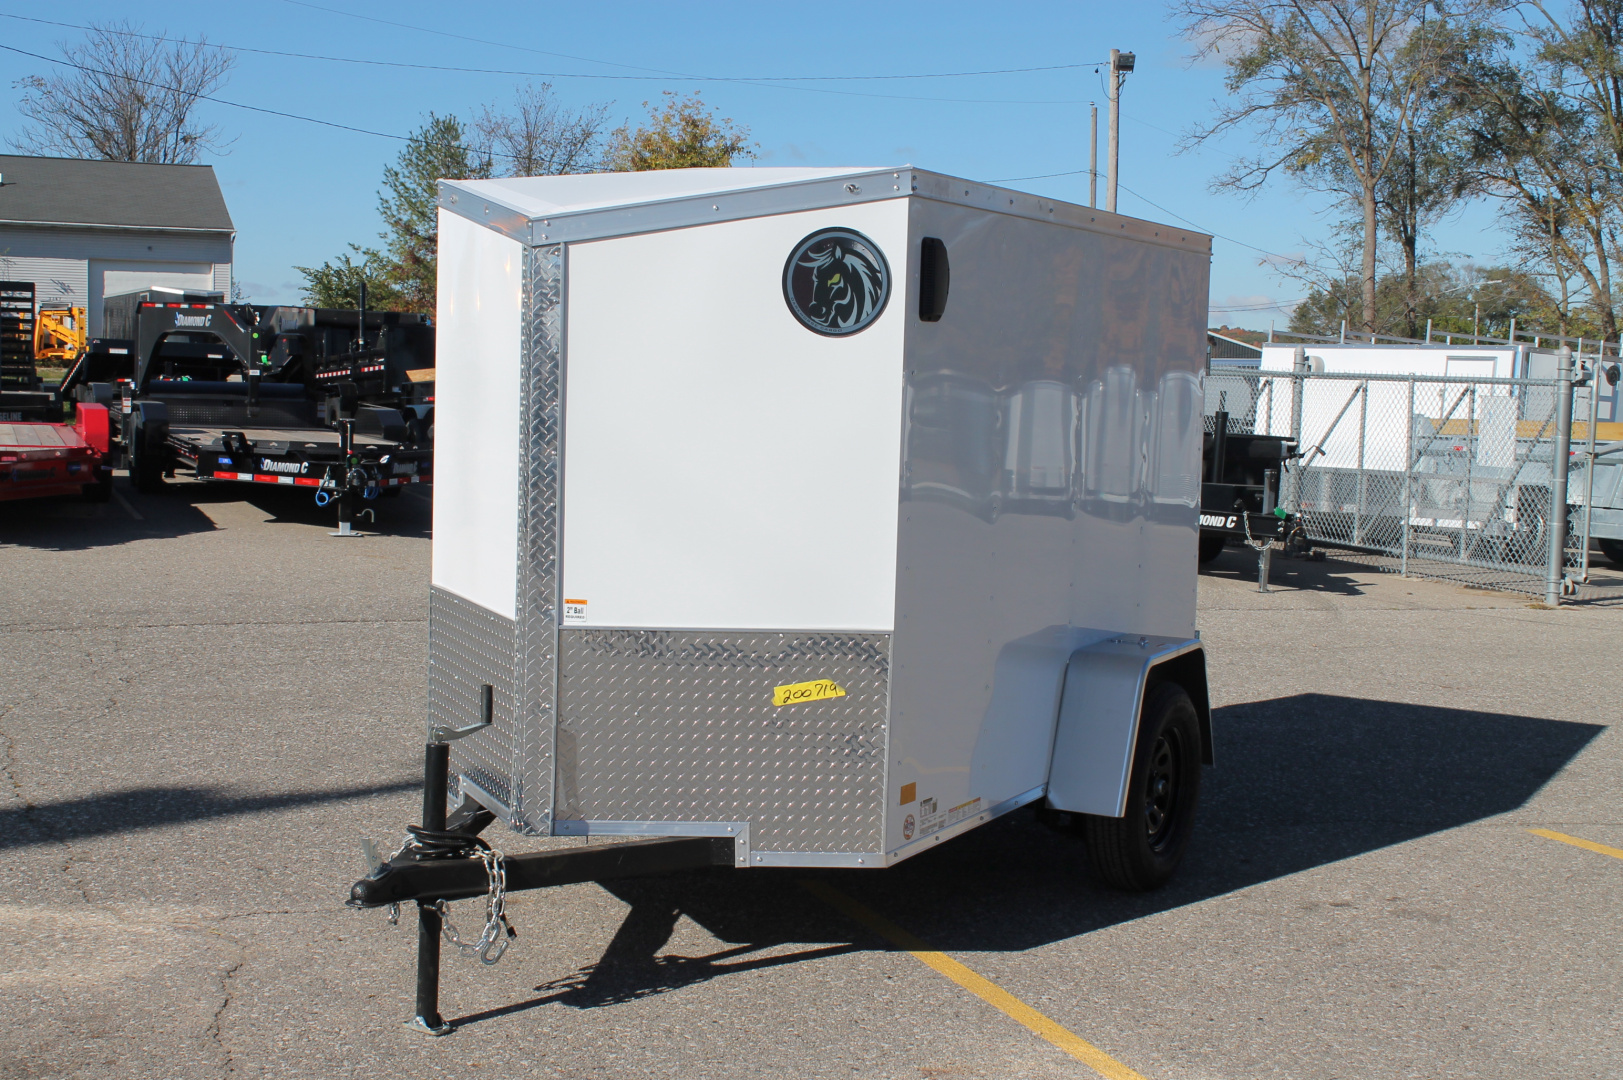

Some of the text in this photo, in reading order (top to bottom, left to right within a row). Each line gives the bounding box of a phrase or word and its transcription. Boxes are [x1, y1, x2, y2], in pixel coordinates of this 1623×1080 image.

[177, 314, 212, 327] DIAMOND C
[263, 459, 309, 474] DIAMOND C
[1226, 515, 1237, 528] C
[573, 606, 584, 614] Ball
